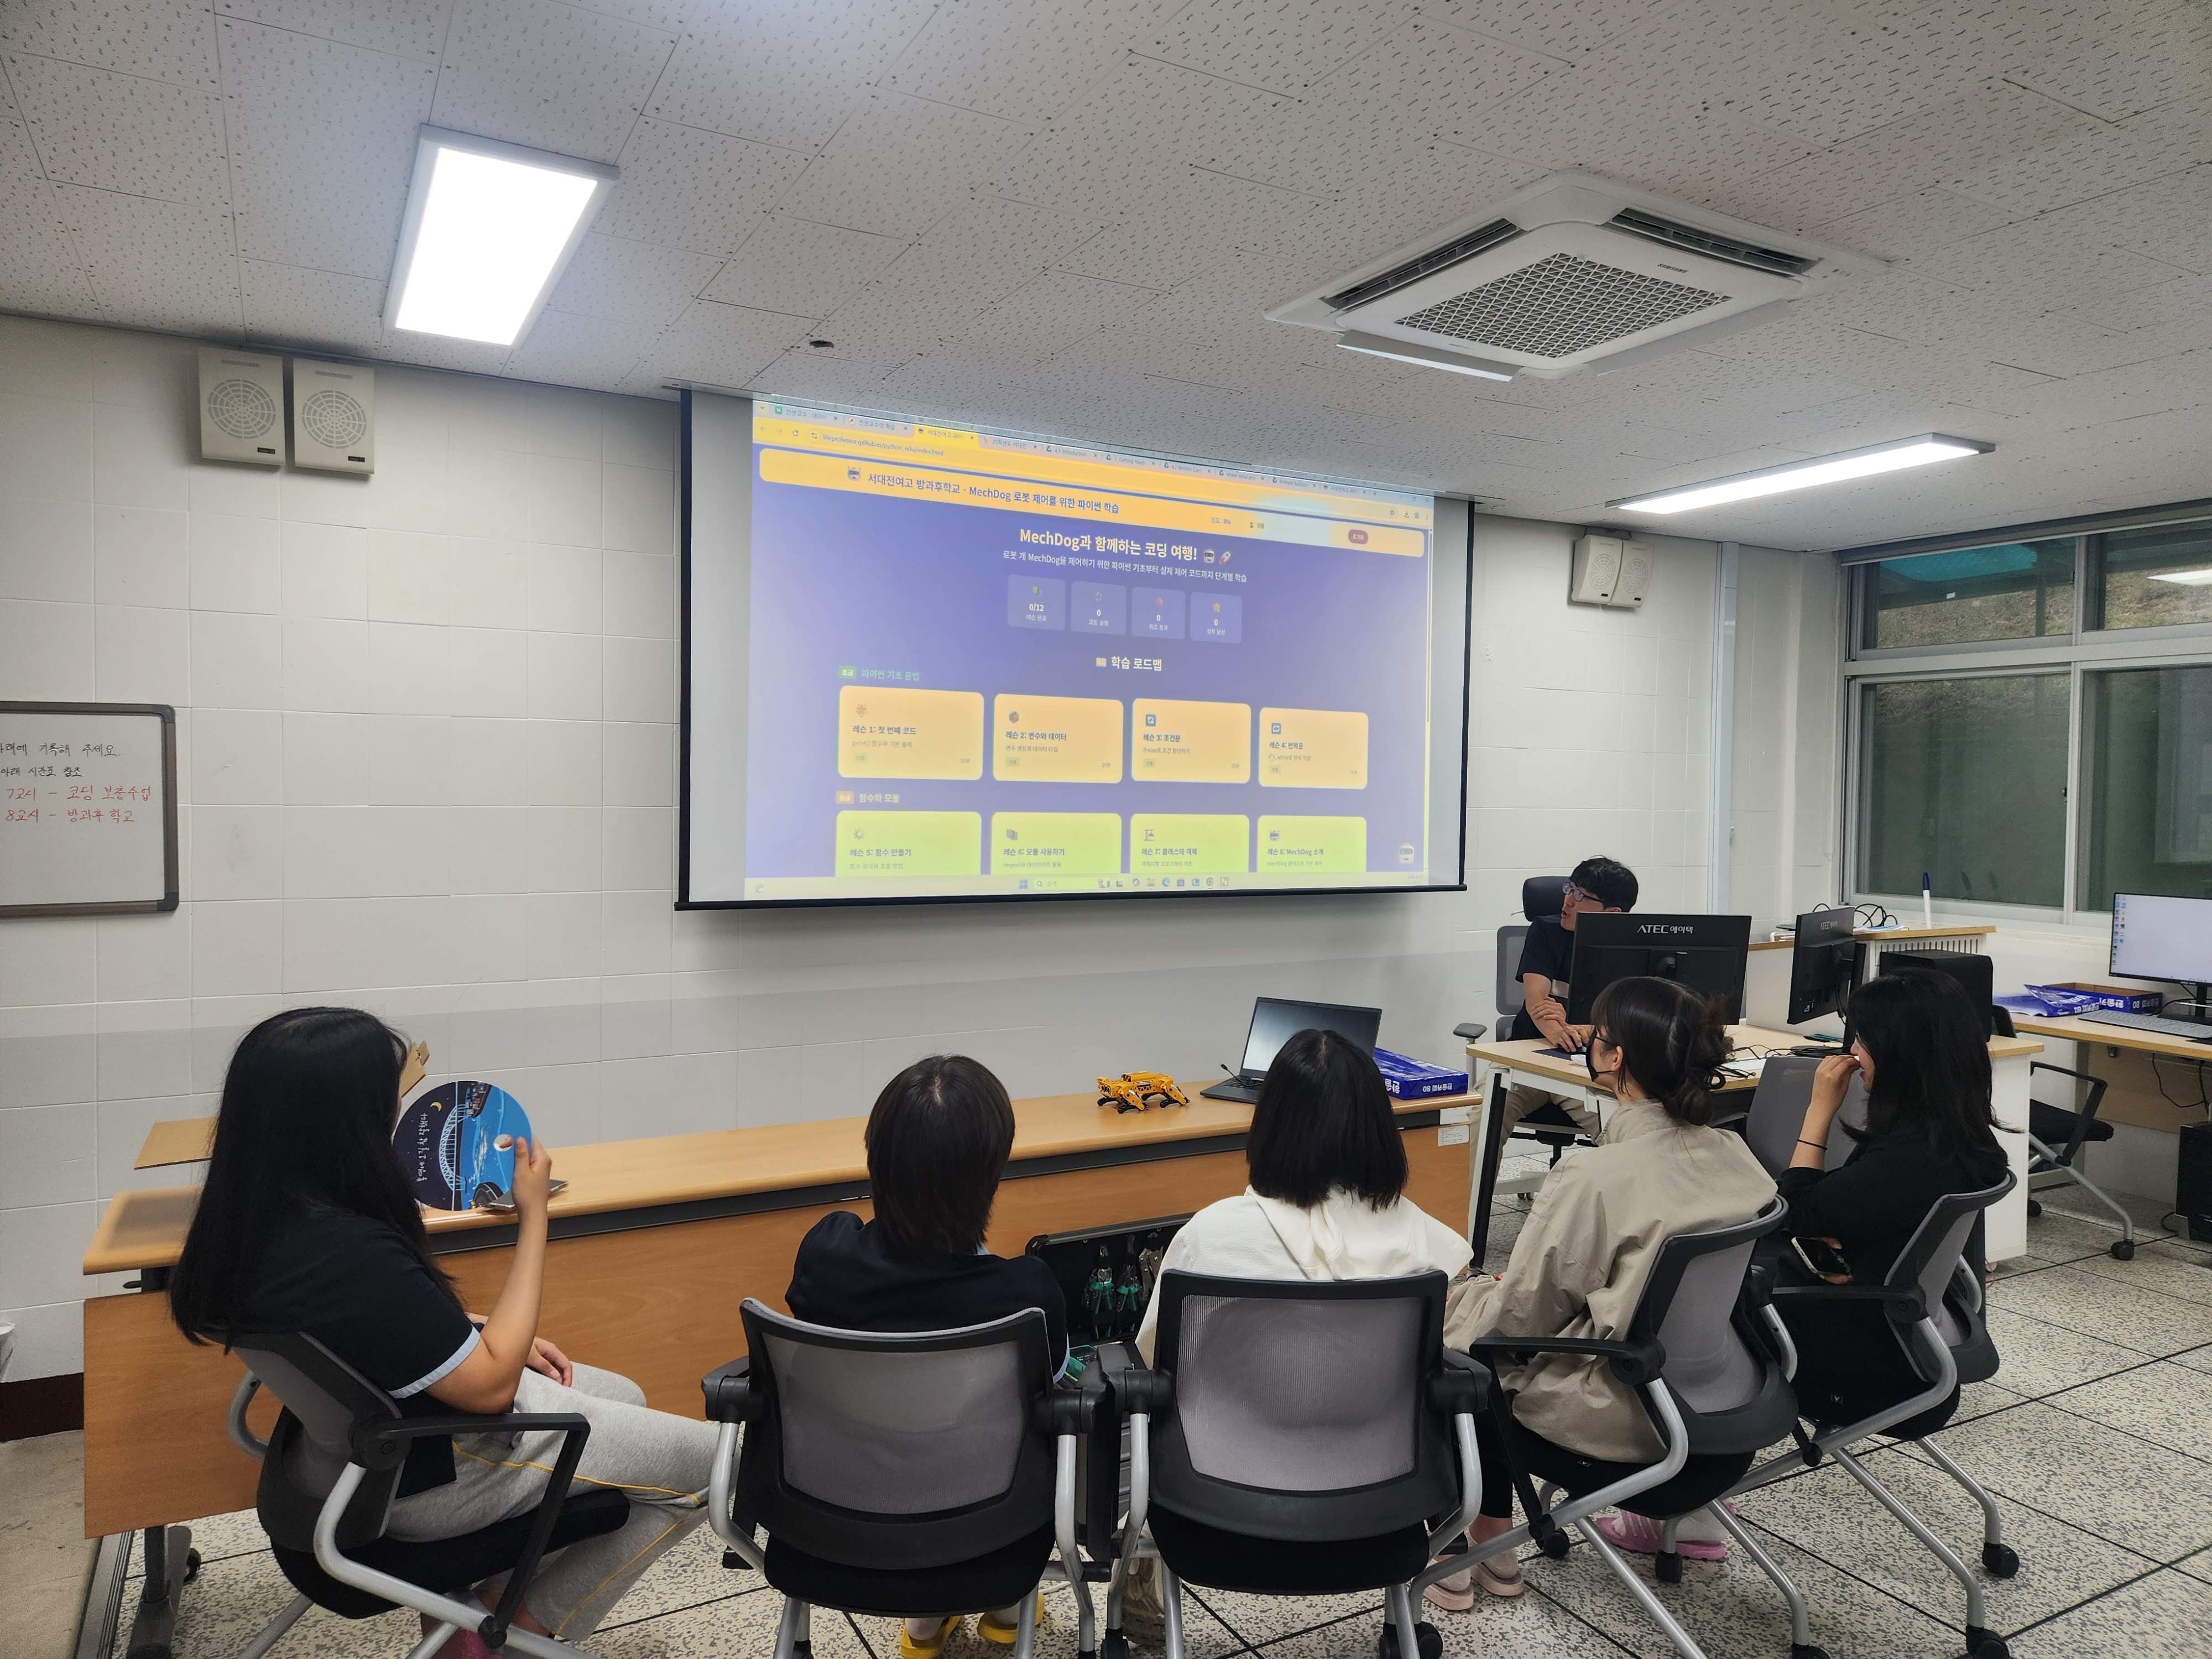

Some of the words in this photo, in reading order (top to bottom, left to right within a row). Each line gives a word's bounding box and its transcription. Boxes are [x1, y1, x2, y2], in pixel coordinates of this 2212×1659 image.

[868, 474, 912, 488] 서대전여고
[917, 479, 960, 493] 방과후학교
[969, 487, 1010, 502] MechDog
[1014, 492, 1029, 503] 로봇
[1033, 494, 1056, 506] 제어를
[1059, 495, 1074, 508] 위한
[1078, 498, 1101, 511] 파이썬
[1104, 502, 1119, 514] 학습
[1020, 529, 1091, 550] MechDog과
[1095, 536, 1141, 556] 함께하는
[1145, 542, 1167, 558] 코딩
[1171, 544, 1197, 561] 여행!
[1003, 550, 1017, 560] 로봇
[1019, 552, 1026, 561] 개
[1028, 554, 1066, 566] MechDog을
[1068, 557, 1095, 568] 제어하기
[1097, 560, 1110, 570] 위한
[1112, 561, 1131, 571] 파이썬
[1133, 564, 1158, 574] 기초부터
[1160, 566, 1172, 576] 실제
[1175, 567, 1187, 577] 제어
[1189, 568, 1213, 580] 코드까지
[1215, 571, 1233, 581] 단계별
[1235, 573, 1246, 583] 학습
[1029, 604, 1044, 612] 0/12
[1111, 656, 1130, 669] 학습
[1133, 658, 1162, 671] 로드맵
[862, 669, 884, 679] 파이썬
[887, 670, 902, 680] 기초
[1048, 733, 1067, 741] 데이터
[39, 743, 70, 757] 기록해
[82, 744, 121, 757] 주세요.
[1, 767, 20, 776] 아래
[28, 767, 56, 777] 시간표
[63, 766, 82, 777] 참조
[7, 788, 35, 800] 7교시
[66, 785, 93, 800] 코딩
[102, 786, 150, 801] 보충수업
[859, 794, 882, 802] 함수와
[6, 809, 39, 823] 8교시
[891, 848, 911, 857] 만들기
[1637, 925, 1669, 933] ATEC
[1670, 926, 1693, 934] 에이텍
[418, 1112, 430, 1136] 잘했다
[416, 1161, 427, 1182] 통영에
